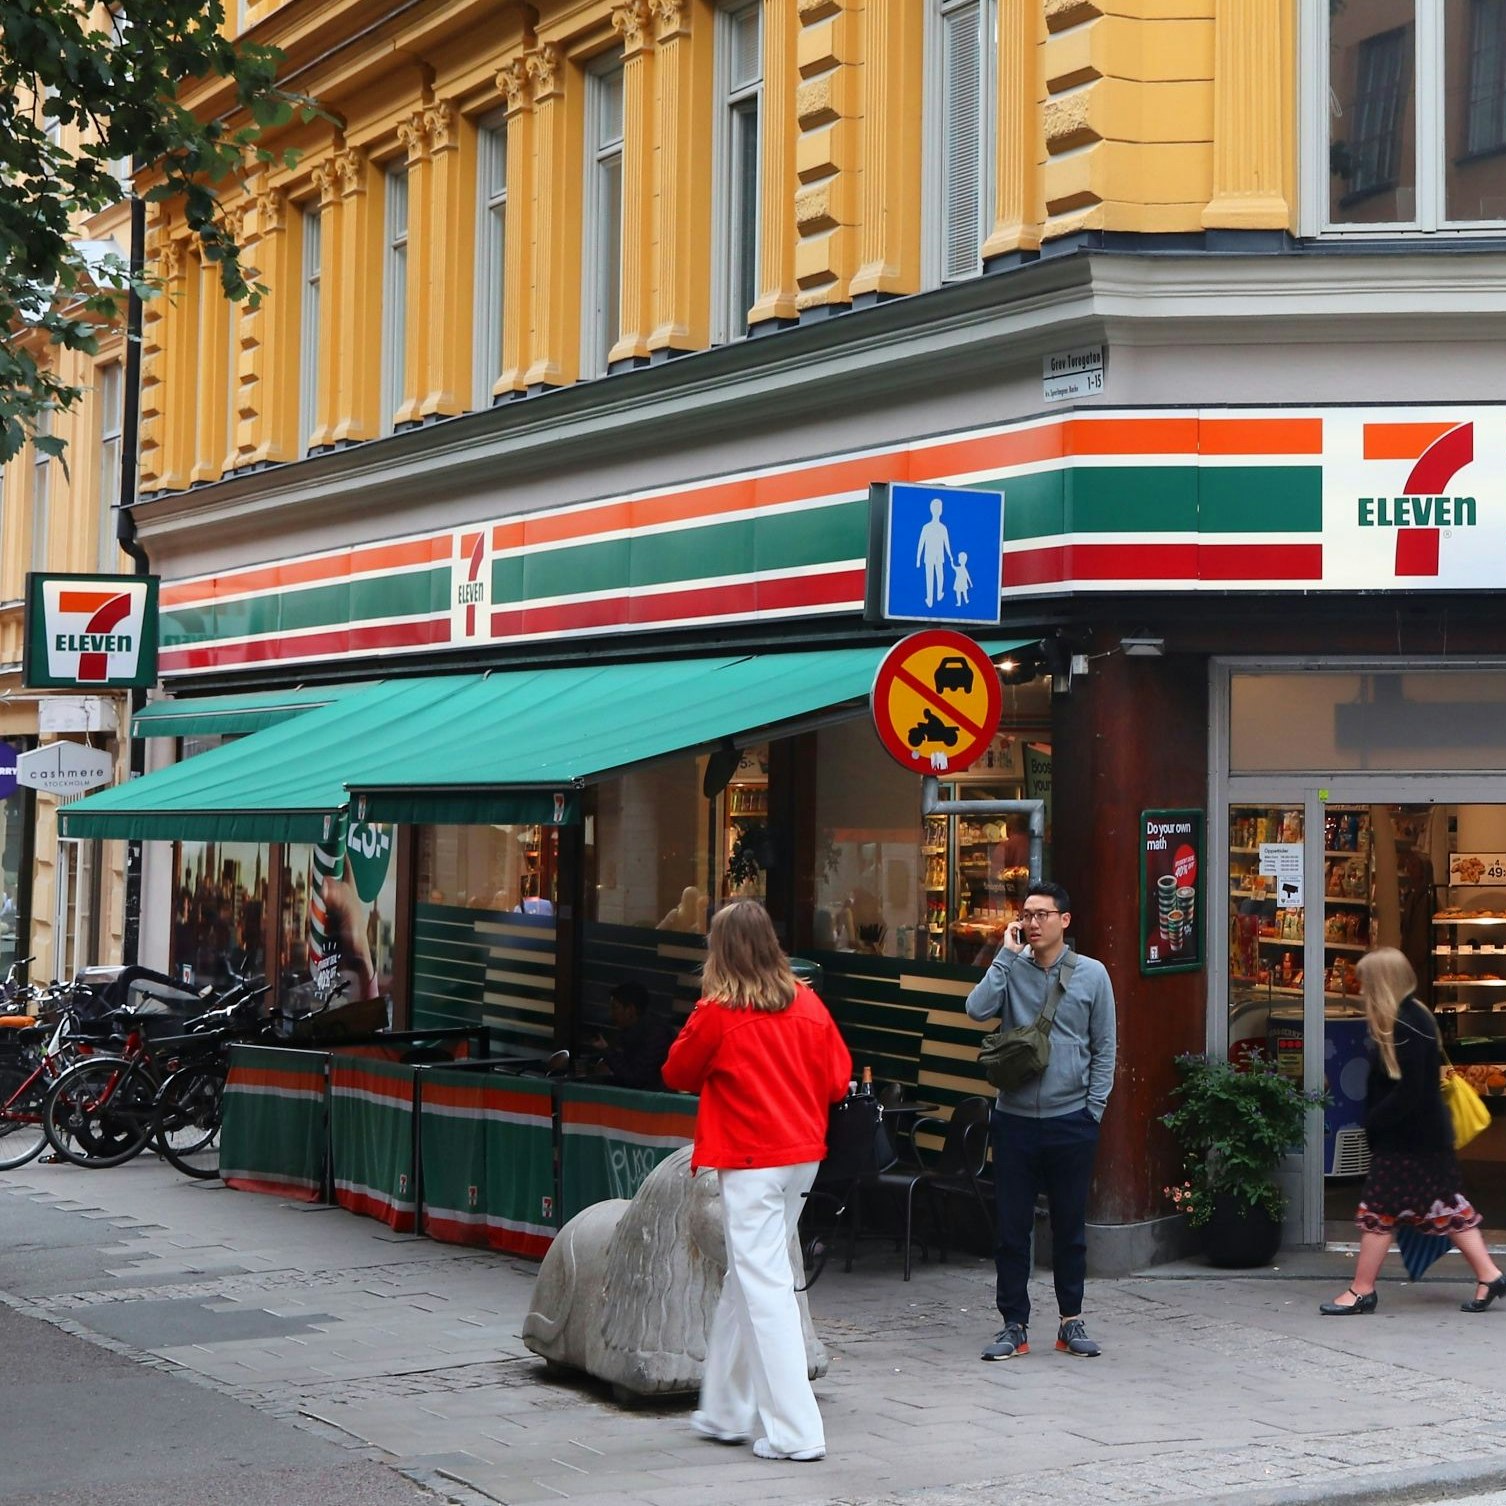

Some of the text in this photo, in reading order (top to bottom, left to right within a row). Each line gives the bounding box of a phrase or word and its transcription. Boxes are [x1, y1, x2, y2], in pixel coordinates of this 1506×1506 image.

[1050, 351, 1101, 371] Grev Turegatan
[1087, 373, 1102, 390] 1-15
[1363, 421, 1474, 576] 7
[59, 591, 131, 680] 7
[44, 780, 90, 788] STOCKHOLM
[1146, 822, 1191, 837] Do your own
[1146, 836, 1167, 850] math
